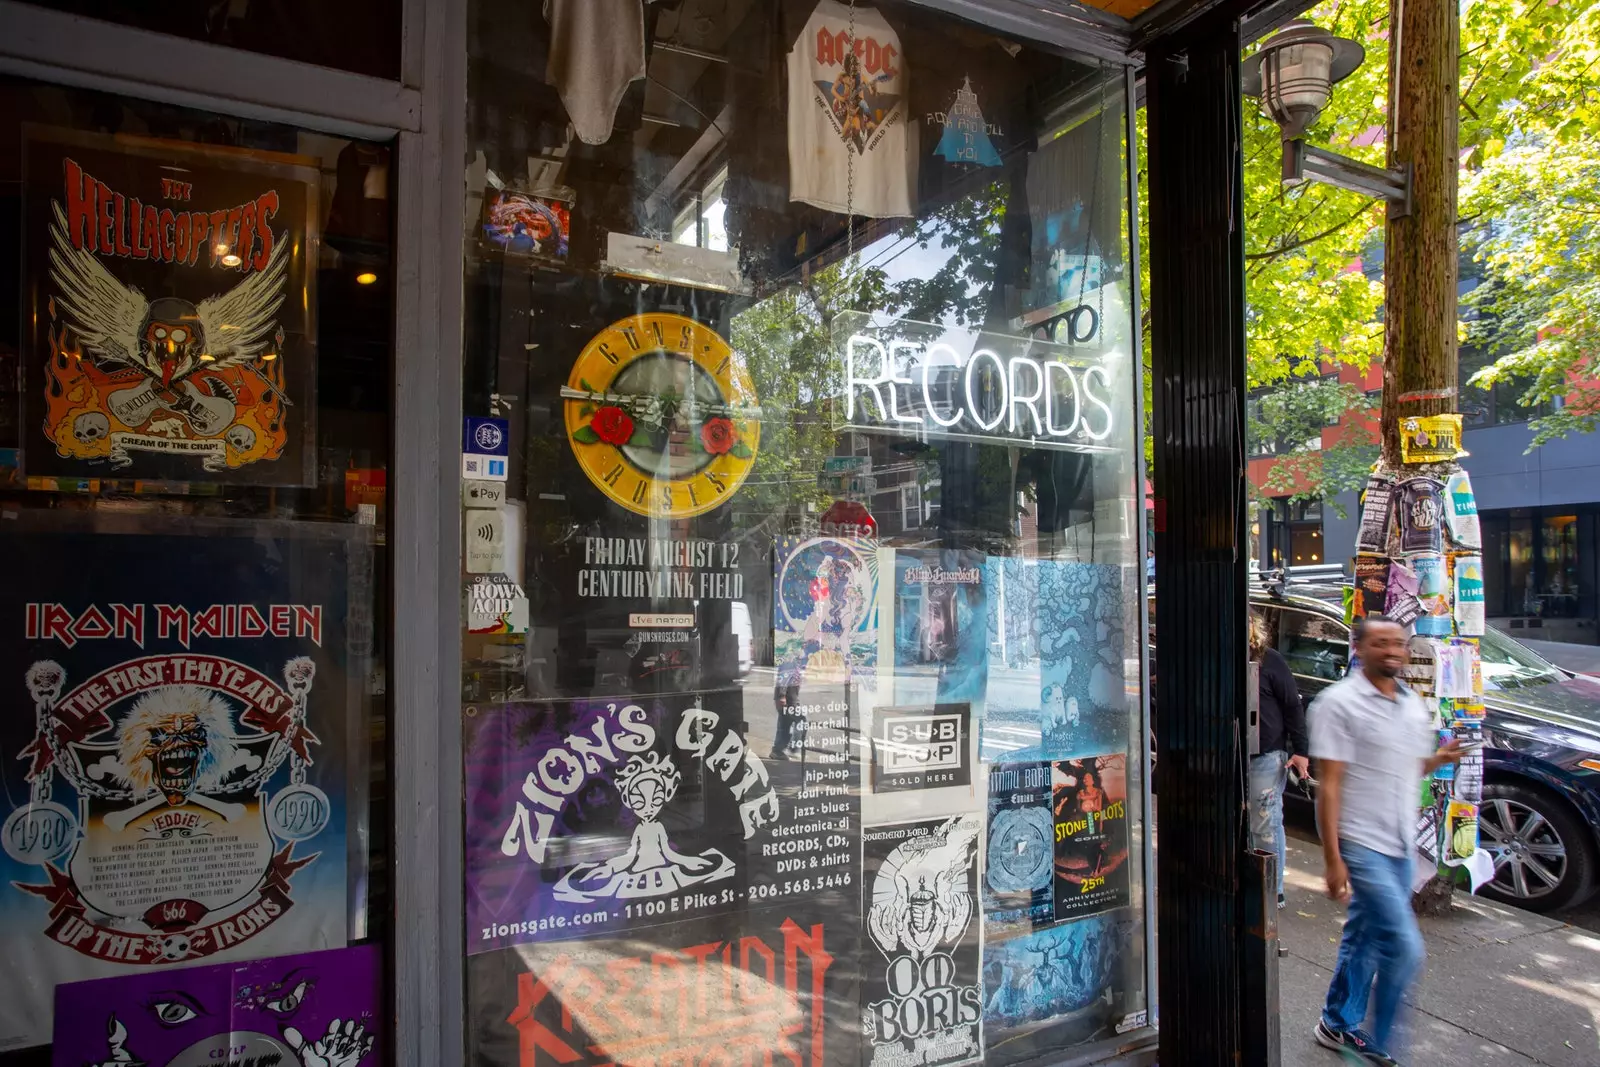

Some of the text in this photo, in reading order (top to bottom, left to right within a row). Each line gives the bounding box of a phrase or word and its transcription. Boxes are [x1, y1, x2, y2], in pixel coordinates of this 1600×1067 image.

[814, 95, 826, 109] THE
[868, 111, 901, 152] WORLD TOUR
[161, 178, 192, 201] THE
[64, 157, 280, 273] HELLACOPTERS
[598, 321, 692, 365] GUNS
[846, 335, 1113, 441] RECORDS
[121, 436, 156, 448] CREAM
[171, 442, 189, 450] THE
[481, 489, 500, 501] Pay
[470, 551, 481, 560] Tap
[490, 552, 503, 560] pay
[585, 536, 739, 568] FRIDAY AUGUST 12
[577, 569, 743, 599] CENTURYLINK FIELD
[904, 566, 933, 584] Blind
[473, 599, 513, 613] ACID
[25, 602, 323, 650] IRON MAIDEN
[632, 616, 692, 624] LIVE NATION
[638, 631, 689, 643] GUNSNROSES.COM
[60, 682, 110, 720] THE
[108, 660, 167, 693] FIRST
[217, 661, 284, 714] YEARS
[796, 717, 848, 732] dancehall
[819, 752, 849, 763] metal
[501, 703, 779, 864] ZION'S GATE
[806, 768, 849, 783] hip-hop
[891, 773, 954, 786] SOLD HERE
[989, 770, 1020, 792] IMMU
[282, 797, 322, 829] 1990
[18, 817, 66, 850] 1980
[861, 829, 906, 842] SOUTHERN
[907, 827, 929, 837] LORD
[1055, 819, 1087, 843] STONE
[1074, 833, 1106, 843] CORE
[762, 835, 849, 857] RECORDS, CDs,
[776, 852, 850, 873] DVDs & shirts
[1062, 887, 1120, 903] ANNIVERSARY
[1080, 876, 1105, 894] 25TH
[162, 902, 187, 919] 666
[482, 872, 851, 940] zionsgate.com 1100 E Pike St 206.568.5446
[1066, 894, 1117, 910] COLLECTION
[56, 915, 93, 946] UP
[93, 929, 145, 960] THE
[867, 983, 982, 1046] BORIS
